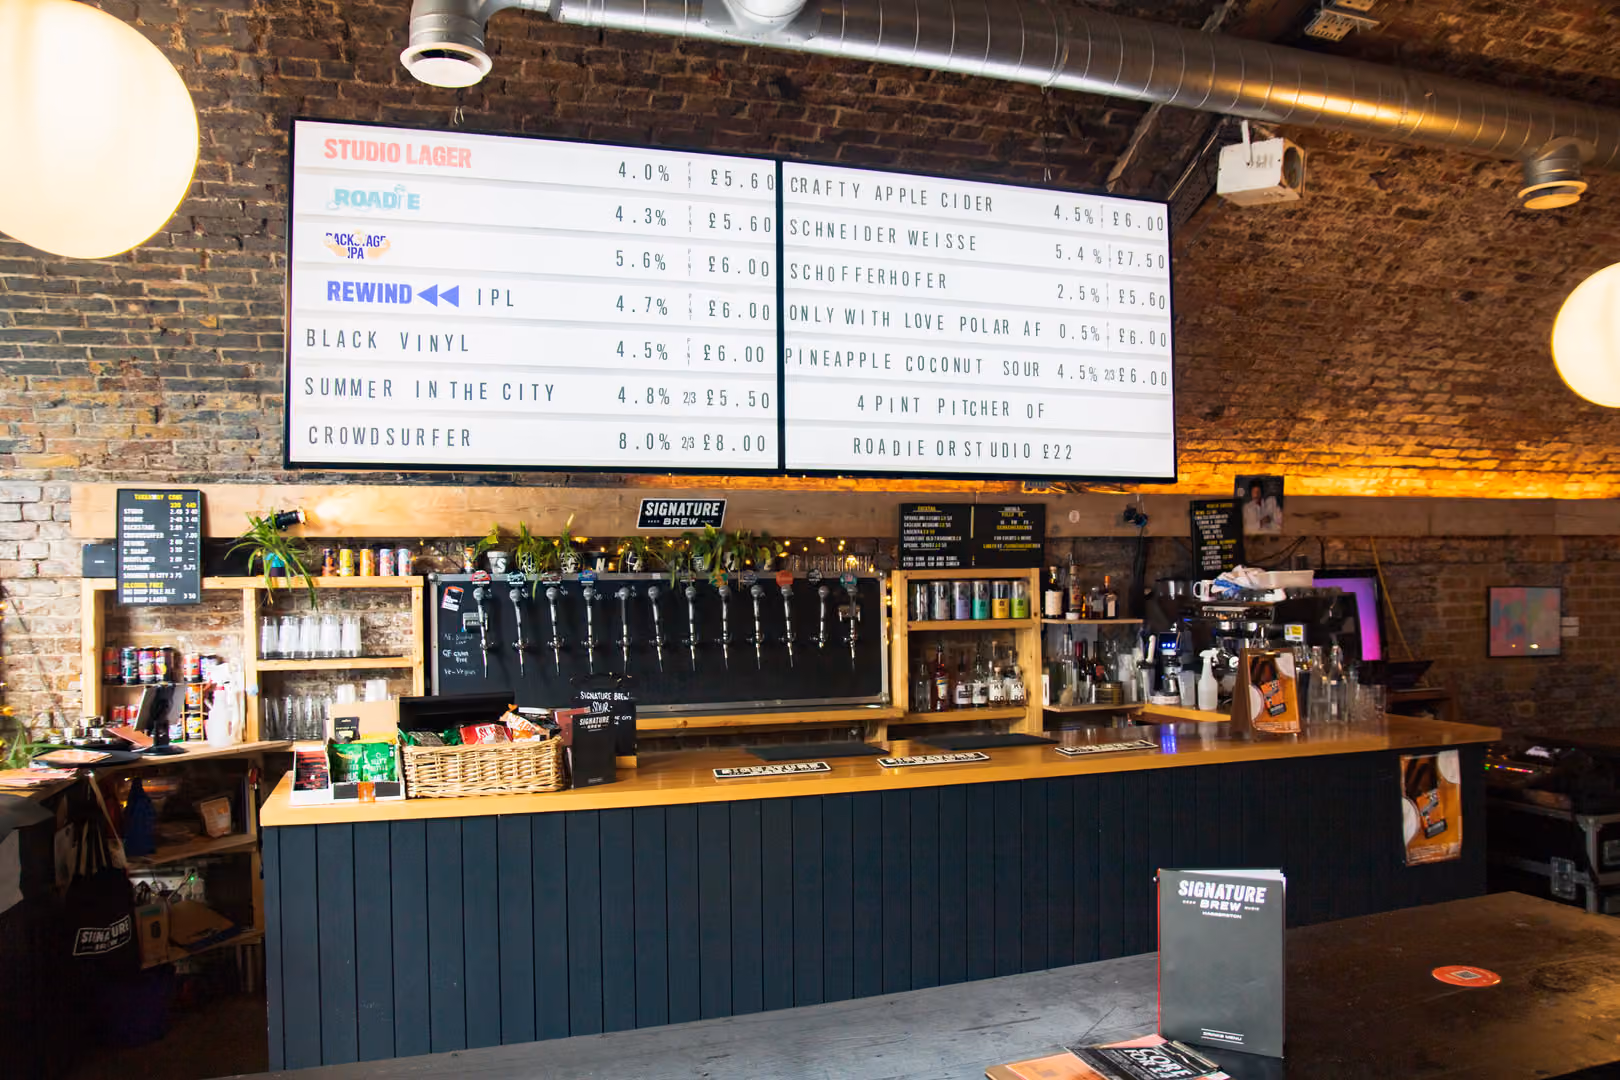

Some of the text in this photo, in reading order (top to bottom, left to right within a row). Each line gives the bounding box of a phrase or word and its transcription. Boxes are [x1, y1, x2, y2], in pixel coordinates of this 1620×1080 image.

[324, 138, 402, 164] STUDIO
[405, 142, 474, 170] LAGER
[618, 160, 670, 182] 4.0%
[710, 168, 775, 191] £5.60
[334, 184, 421, 210] ROADIE
[615, 204, 667, 227] 4.3%
[708, 211, 772, 233] £5.60
[790, 176, 860, 199] CRAFTY
[874, 184, 927, 206] APPLE
[940, 192, 993, 213] CIDER
[1053, 204, 1094, 225] 4.5%
[1113, 210, 1164, 232] £6.00
[325, 231, 387, 247] ACKAG
[789, 218, 896, 244] SCHNEIDER
[907, 229, 976, 251] WEISSE
[1055, 243, 1102, 265] 5.4%
[1117, 249, 1165, 270] £7.50
[347, 246, 364, 259] IPA
[615, 249, 666, 271] 5.6%
[708, 255, 770, 278] £6.00
[327, 280, 413, 305] REWIND
[477, 287, 515, 308] IPL
[615, 294, 668, 316] 4.7%
[708, 299, 770, 321] £6.00
[790, 262, 946, 289] SCHOFFERHOFER
[1057, 283, 1100, 304] 2.5%
[1118, 288, 1166, 310] £5.60
[789, 303, 834, 324] ONLY
[844, 307, 890, 328] WITH
[904, 312, 944, 331] LOVE
[959, 316, 1010, 335] POLAR
[1023, 320, 1041, 337] AF
[1059, 323, 1100, 342] 0.5%
[1118, 327, 1167, 348] £6.00
[306, 328, 377, 350] BLACK
[399, 331, 469, 353] VINYL
[616, 340, 668, 361] 4.5%
[703, 343, 764, 363] £6.00
[785, 347, 891, 370] PINEAPPLE
[905, 355, 983, 374] COCONUT
[1003, 360, 1040, 377] SOUR
[1057, 363, 1098, 383] 4.5%
[1118, 367, 1167, 387] £6.00
[304, 376, 393, 399] SUMMER
[415, 379, 438, 399] IN
[449, 380, 488, 401] THE
[502, 382, 554, 402] CITY
[617, 385, 670, 406] 4.8%
[706, 388, 770, 409] £5.50
[857, 394, 1045, 419] 4 PINT PITCHER OF
[308, 425, 471, 447] CROWDSURFER
[618, 431, 671, 451] 8.0%
[703, 433, 766, 453] £8.00
[853, 437, 925, 457] ROADIE
[1042, 443, 1072, 460] £22
[645, 502, 720, 516] SIGNATURE
[663, 517, 698, 526] BREW
[579, 715, 610, 726] SIGNATURE
[1178, 880, 1267, 904] SIGNATURE
[1200, 899, 1242, 912] BREW
